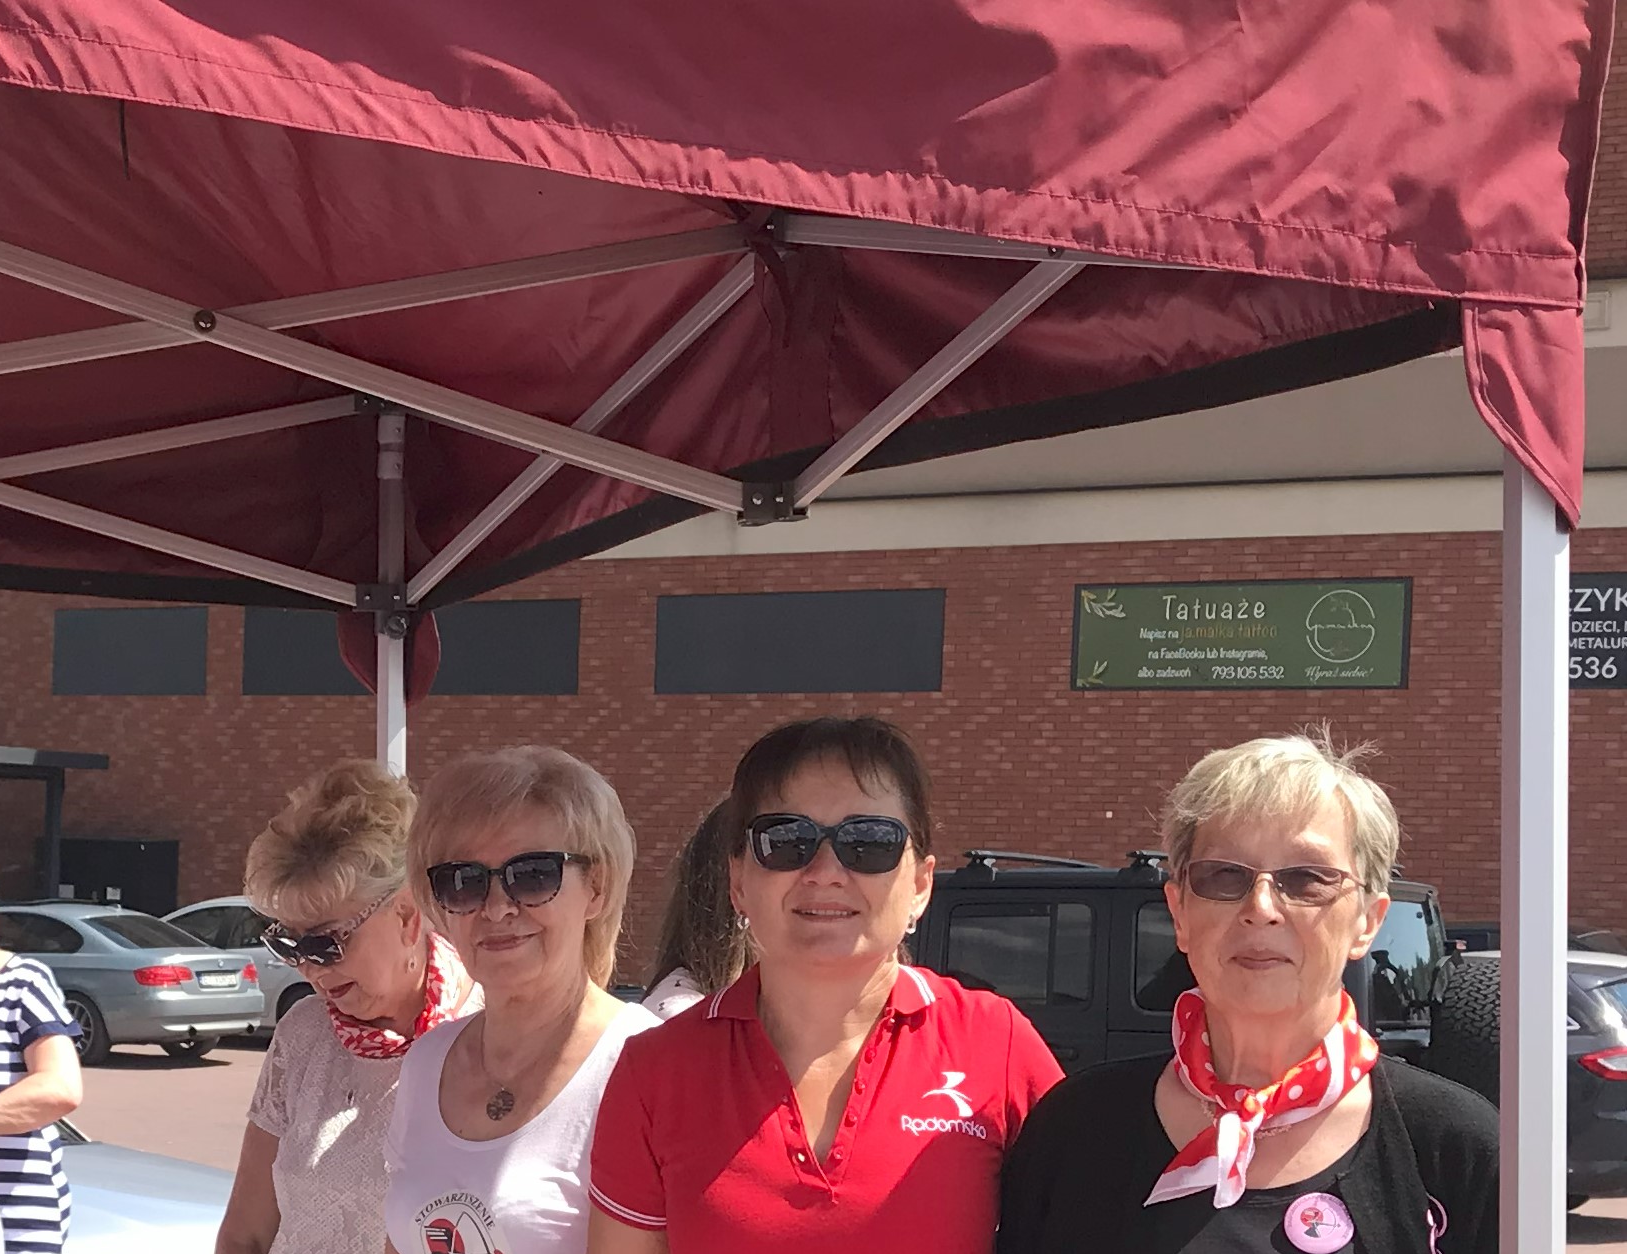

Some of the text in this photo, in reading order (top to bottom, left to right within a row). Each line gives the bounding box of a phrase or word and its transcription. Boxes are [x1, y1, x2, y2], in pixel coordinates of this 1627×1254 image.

[1162, 594, 1266, 621] Tatuaże
[1569, 588, 1627, 617] ZYK
[1167, 630, 1179, 639] na
[1571, 620, 1620, 634] DZIECI,
[1148, 651, 1159, 659] na
[1206, 646, 1219, 659] lub
[1138, 666, 1155, 678] albo
[1211, 666, 1236, 680] 793
[1236, 666, 1258, 679] 105
[1259, 666, 1284, 680] 532
[1569, 656, 1618, 679] 536
[900, 1114, 987, 1140] Radomsko
[414, 1192, 496, 1231] STOWARZYSZENIE
